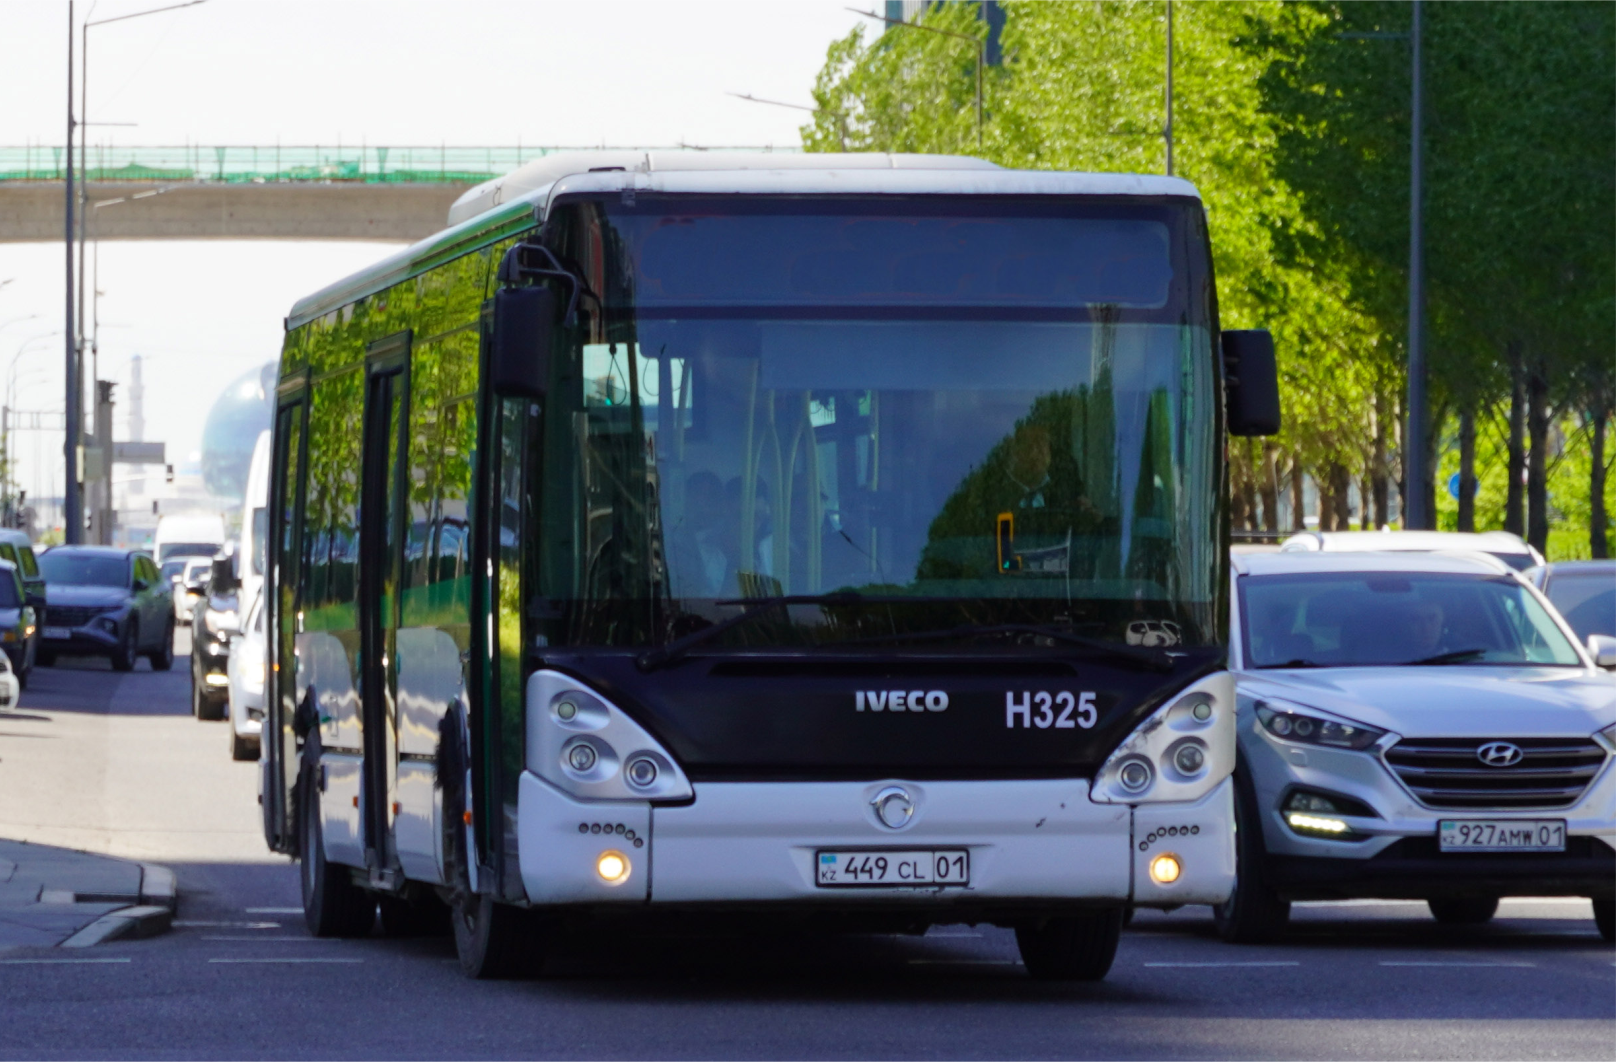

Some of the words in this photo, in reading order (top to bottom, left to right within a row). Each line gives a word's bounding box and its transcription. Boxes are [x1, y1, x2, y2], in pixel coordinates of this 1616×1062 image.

[855, 690, 948, 712] IVECO
[1006, 691, 1097, 728] H325
[1538, 826, 1563, 845] 01
[821, 870, 836, 881] KZ
[844, 856, 888, 880] 449
[898, 861, 925, 879] CL
[936, 856, 964, 879] 01
